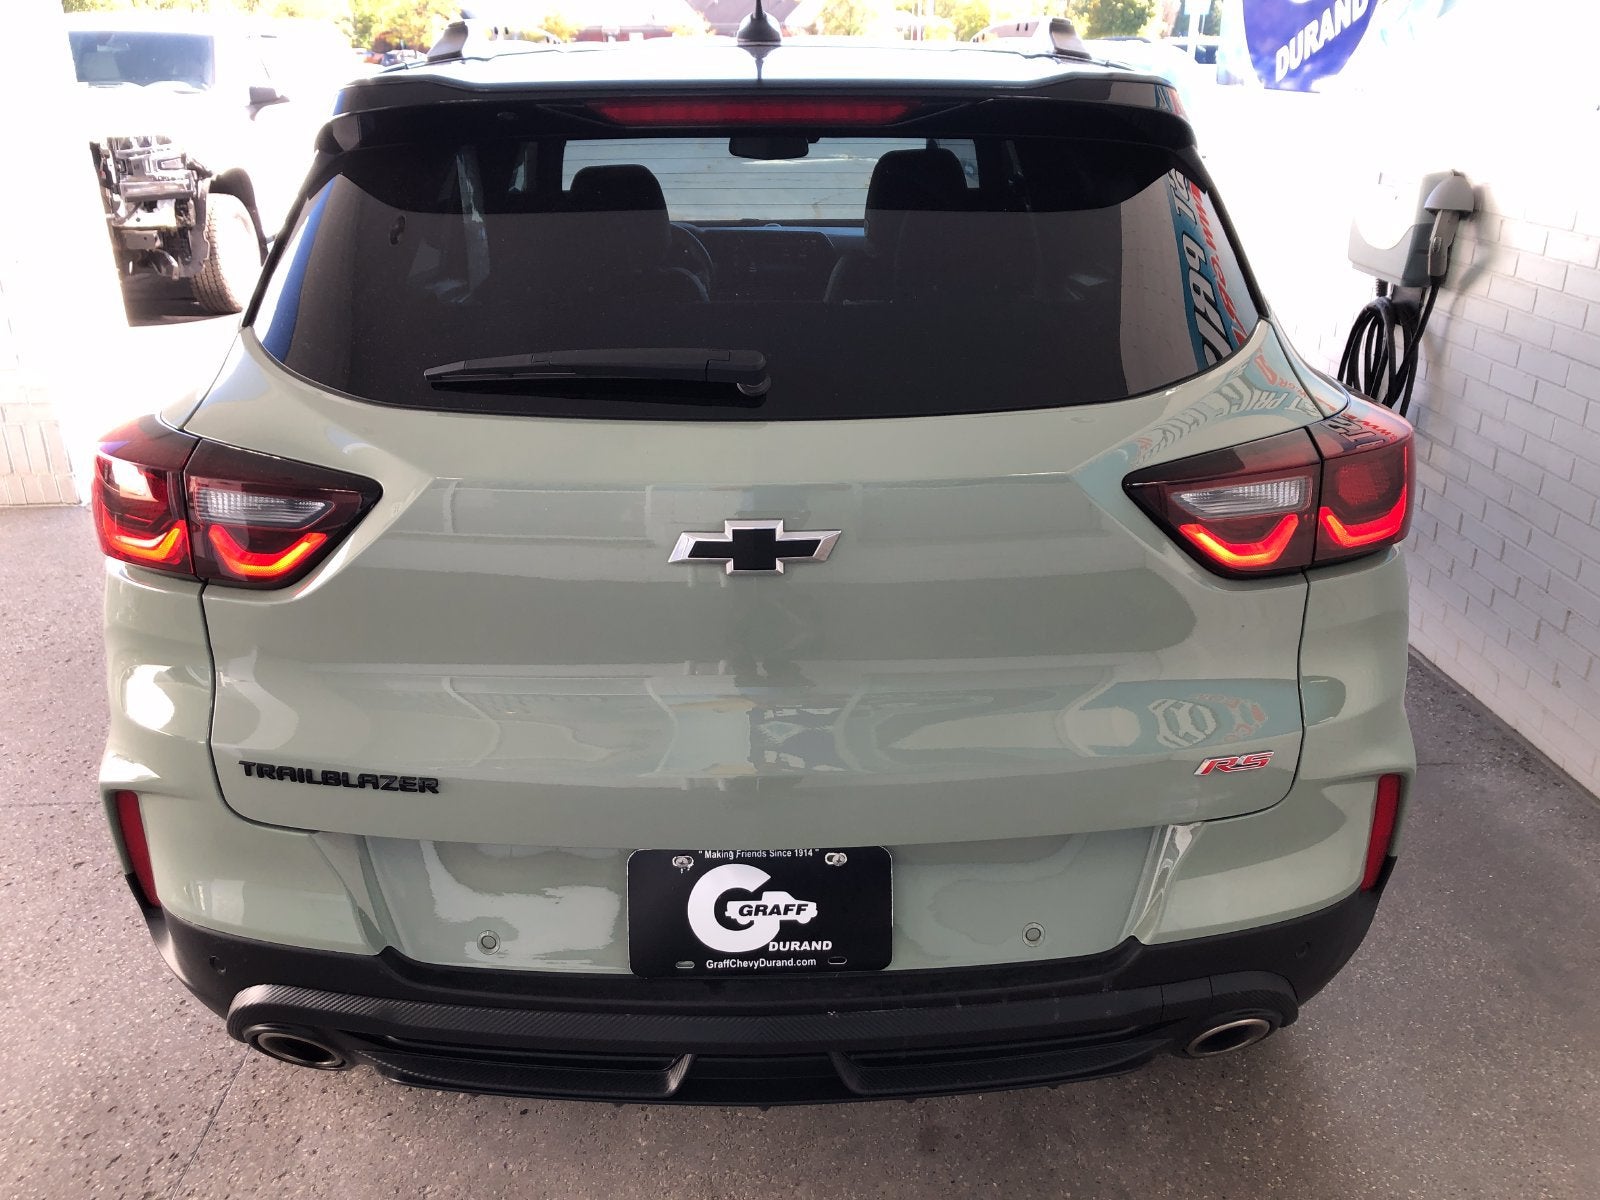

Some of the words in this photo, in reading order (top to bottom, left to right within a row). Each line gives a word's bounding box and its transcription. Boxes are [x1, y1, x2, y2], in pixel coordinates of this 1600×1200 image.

[1275, 0, 1370, 83] DURAND
[1193, 750, 1274, 776] RS
[239, 760, 440, 794] TRAILBLAZER
[704, 850, 734, 861] Making
[736, 849, 767, 859] Friends
[769, 849, 792, 858] Since
[794, 848, 814, 858] 1914
[738, 903, 809, 917] GRAFF
[768, 940, 833, 952] DURAND
[706, 957, 817, 970] GraffChevyDurand.com
